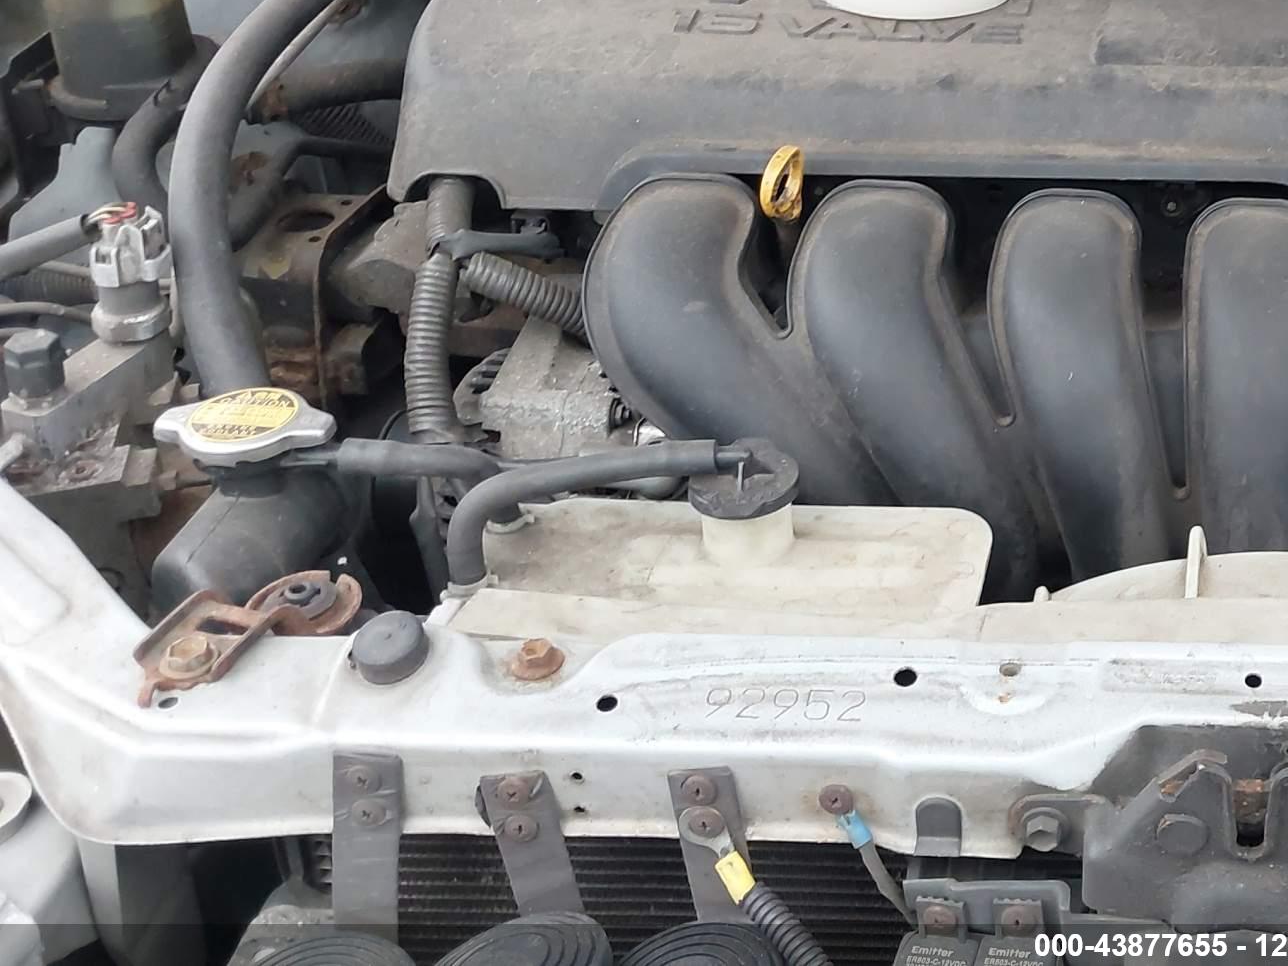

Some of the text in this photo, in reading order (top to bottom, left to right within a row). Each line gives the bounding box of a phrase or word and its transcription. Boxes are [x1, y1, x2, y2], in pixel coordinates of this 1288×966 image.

[672, 8, 1024, 44] 16 VALVE
[704, 687, 867, 722] 92952
[911, 945, 954, 958] Emitter
[988, 946, 1031, 959] Emitter
